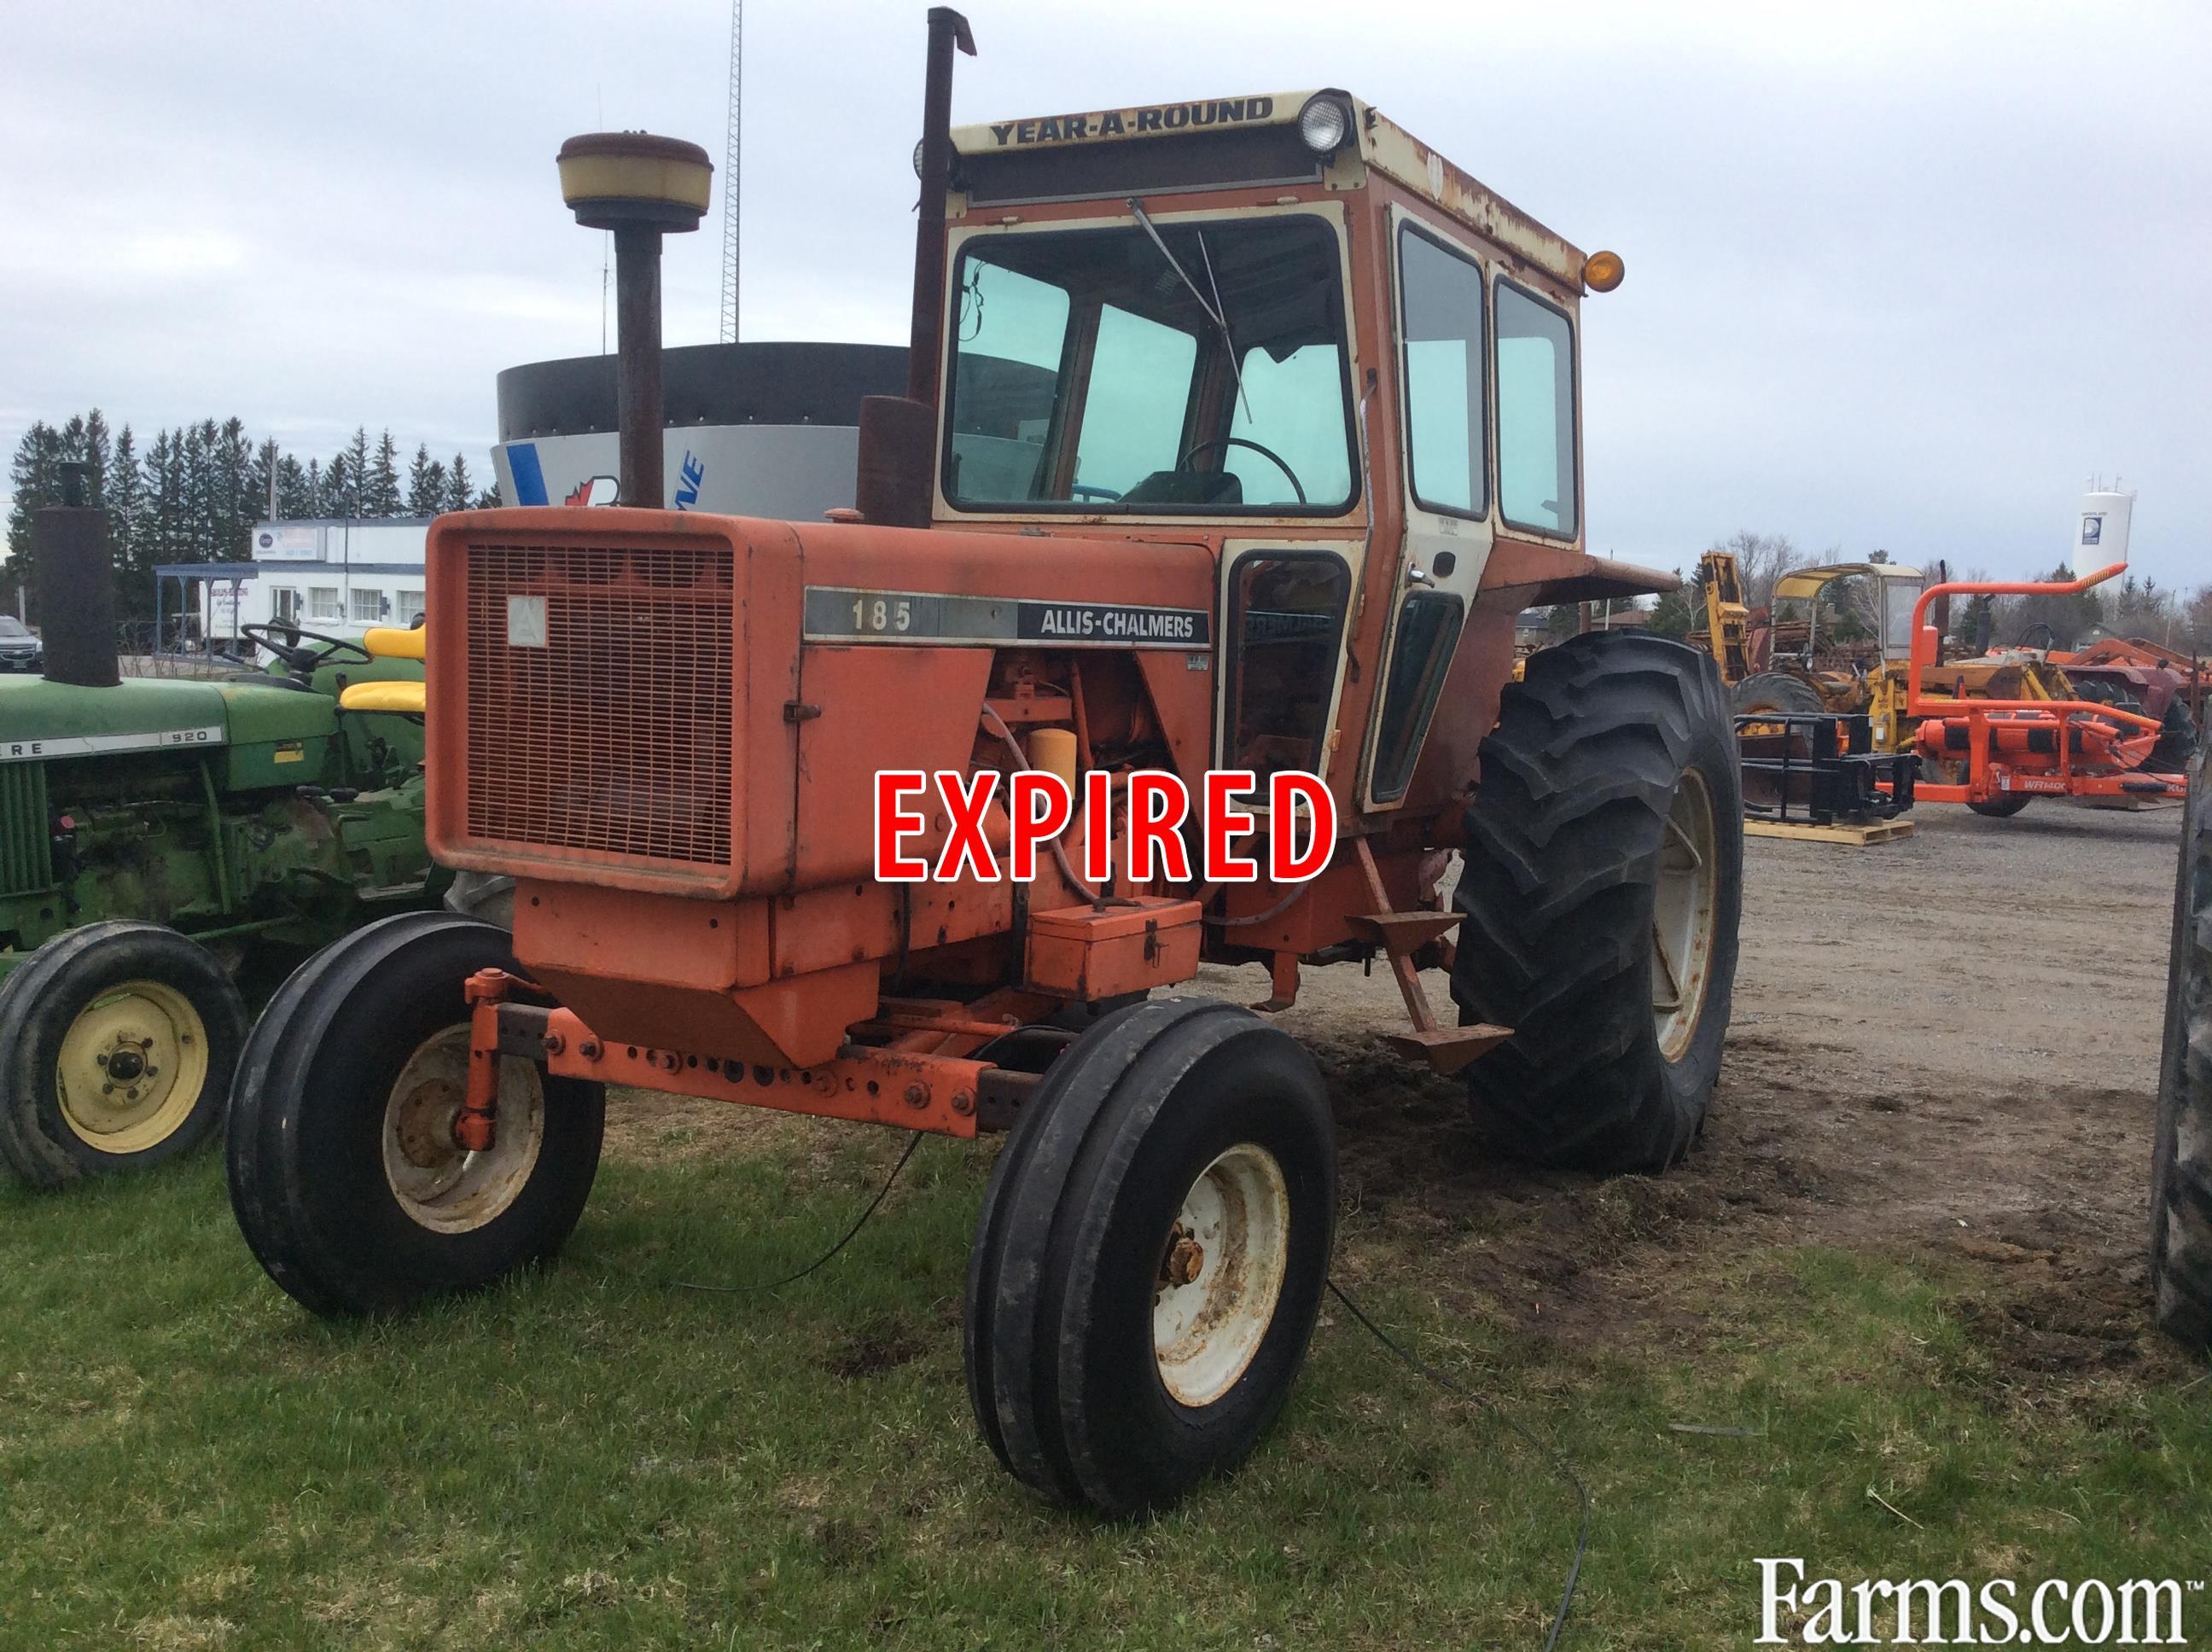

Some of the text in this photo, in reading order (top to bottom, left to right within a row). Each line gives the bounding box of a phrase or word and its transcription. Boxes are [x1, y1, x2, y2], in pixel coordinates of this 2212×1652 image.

[990, 96, 1273, 145] YEAR-A-ROUND
[853, 599, 911, 631] 185
[1040, 608, 1193, 638] ALLIS-CHALMERS
[0, 730, 207, 756] RE 920
